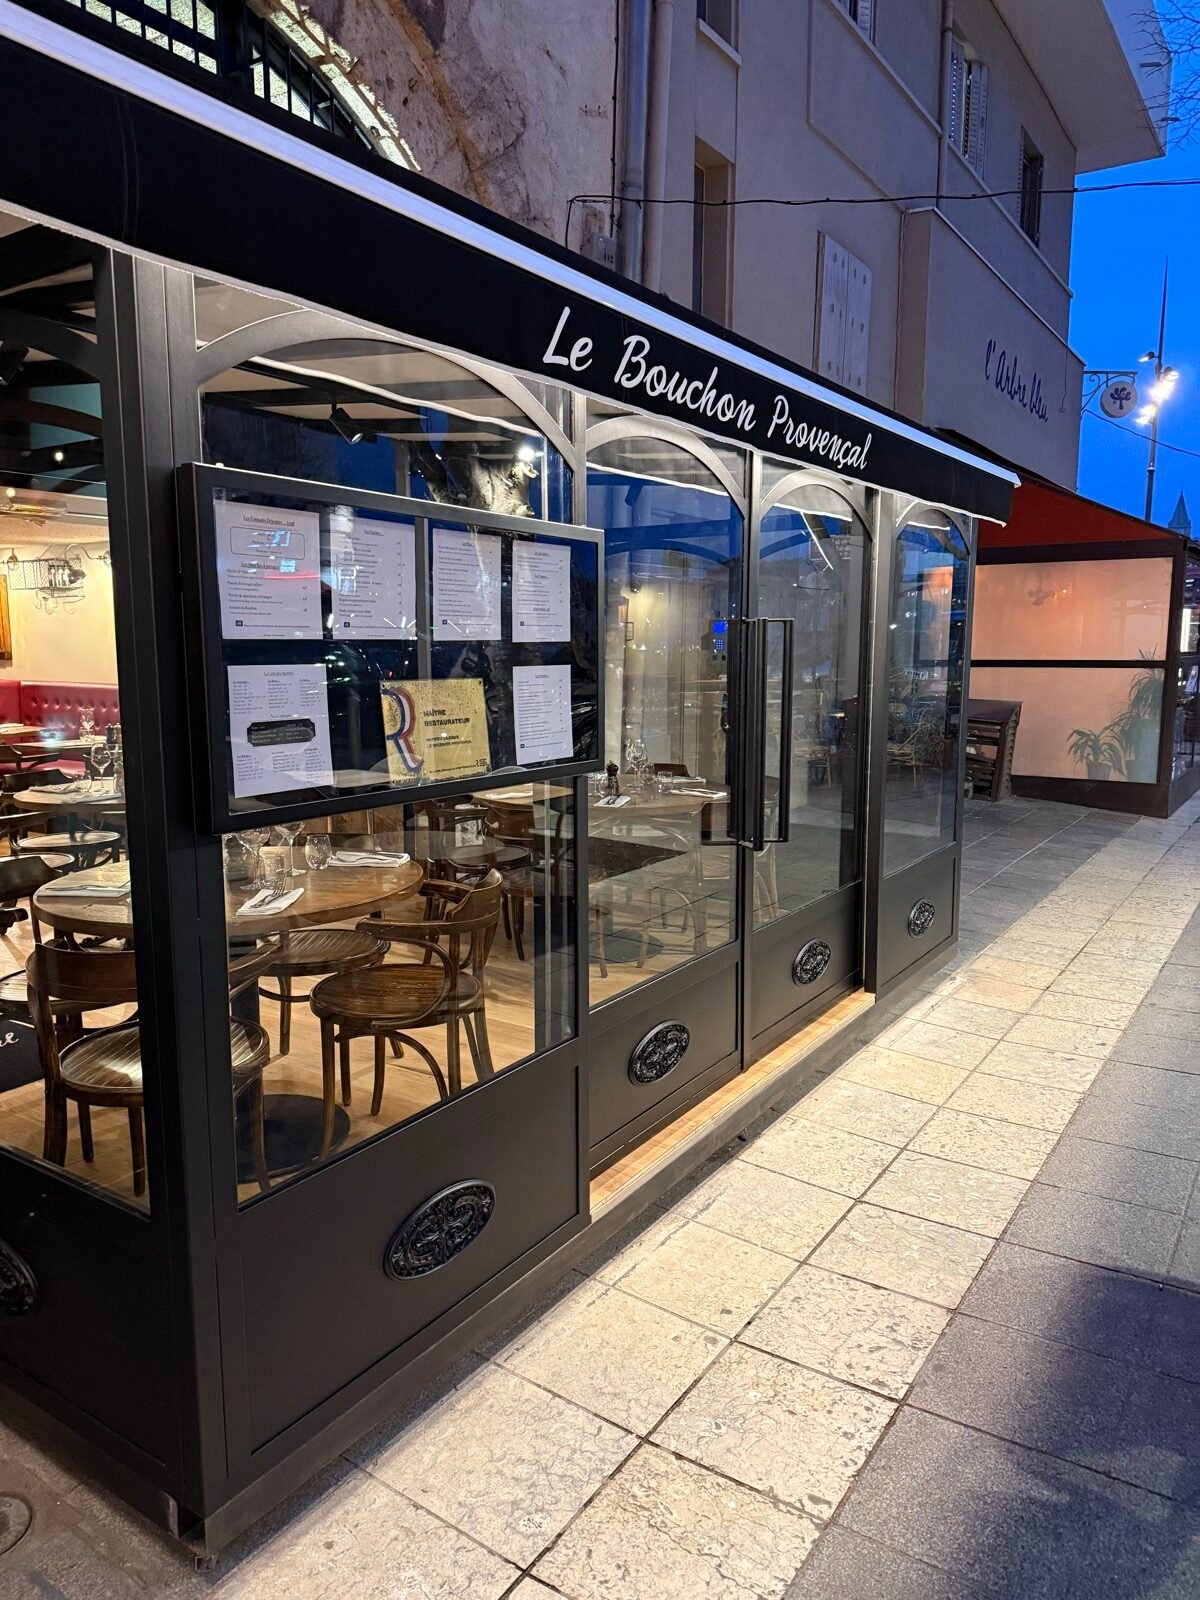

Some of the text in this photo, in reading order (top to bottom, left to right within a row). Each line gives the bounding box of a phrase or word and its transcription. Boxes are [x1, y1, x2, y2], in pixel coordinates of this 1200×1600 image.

[543, 306, 872, 470] Le Bouchon Provençal
[424, 717, 470, 727] RESTAURATEUR
